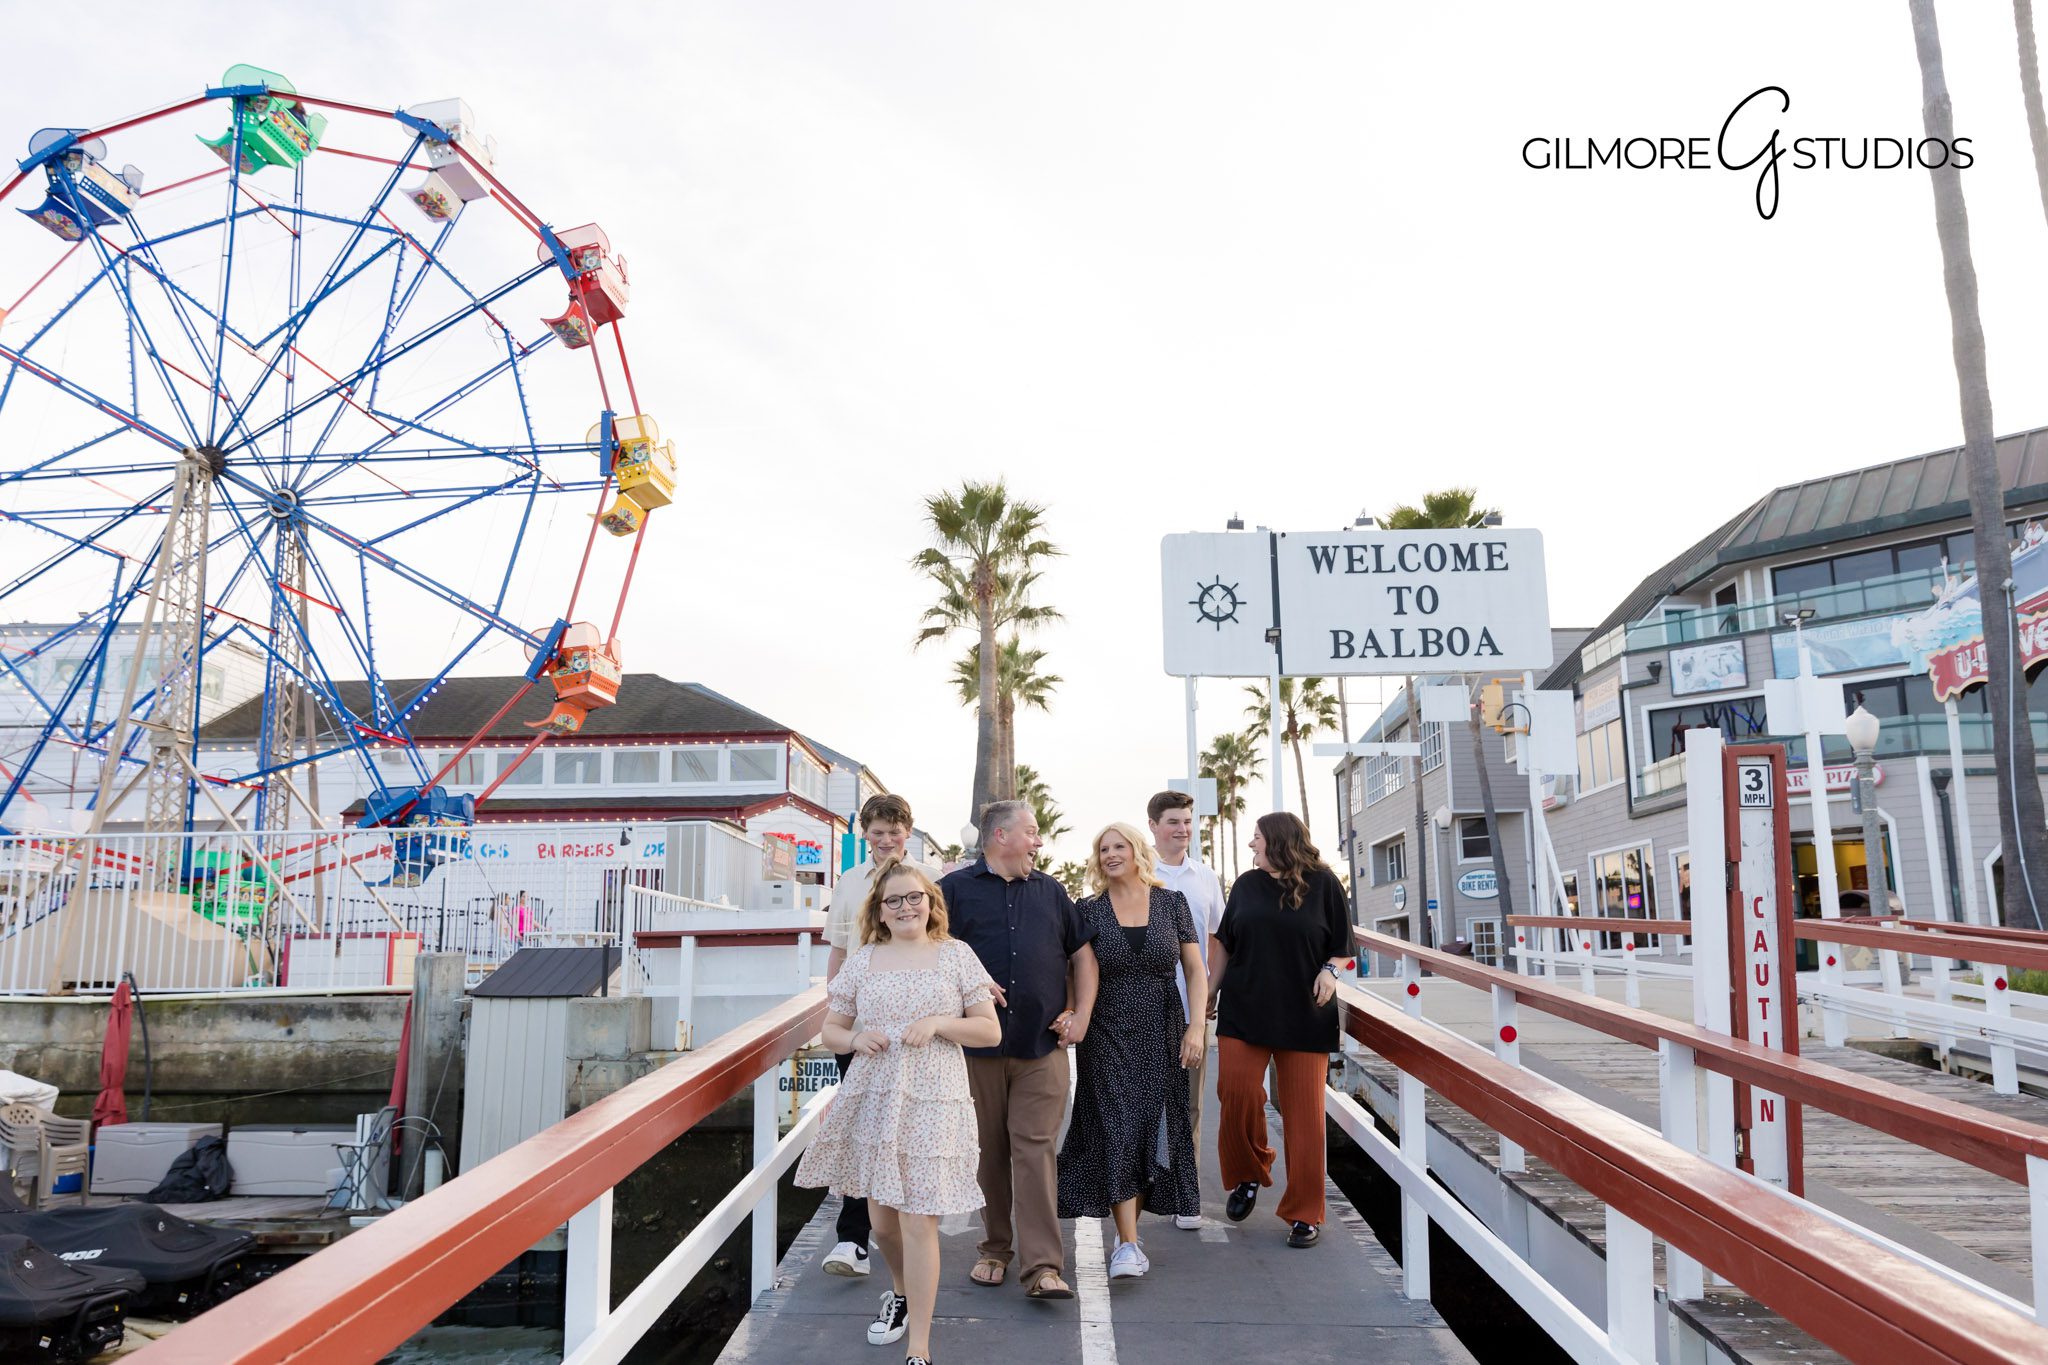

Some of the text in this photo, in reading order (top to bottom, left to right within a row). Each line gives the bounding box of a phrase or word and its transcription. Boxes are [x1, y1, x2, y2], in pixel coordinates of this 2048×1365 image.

[1306, 541, 1509, 574] WELCOME
[1386, 585, 1440, 616] TO
[1329, 625, 1504, 659] BALBOA
[1745, 768, 1764, 792] 3
[1744, 793, 1766, 804] MPH
[1461, 879, 1498, 892] BIKE RENTA
[1753, 896, 1775, 1122] CAUTIN
[779, 1077, 818, 1092] CABLE
